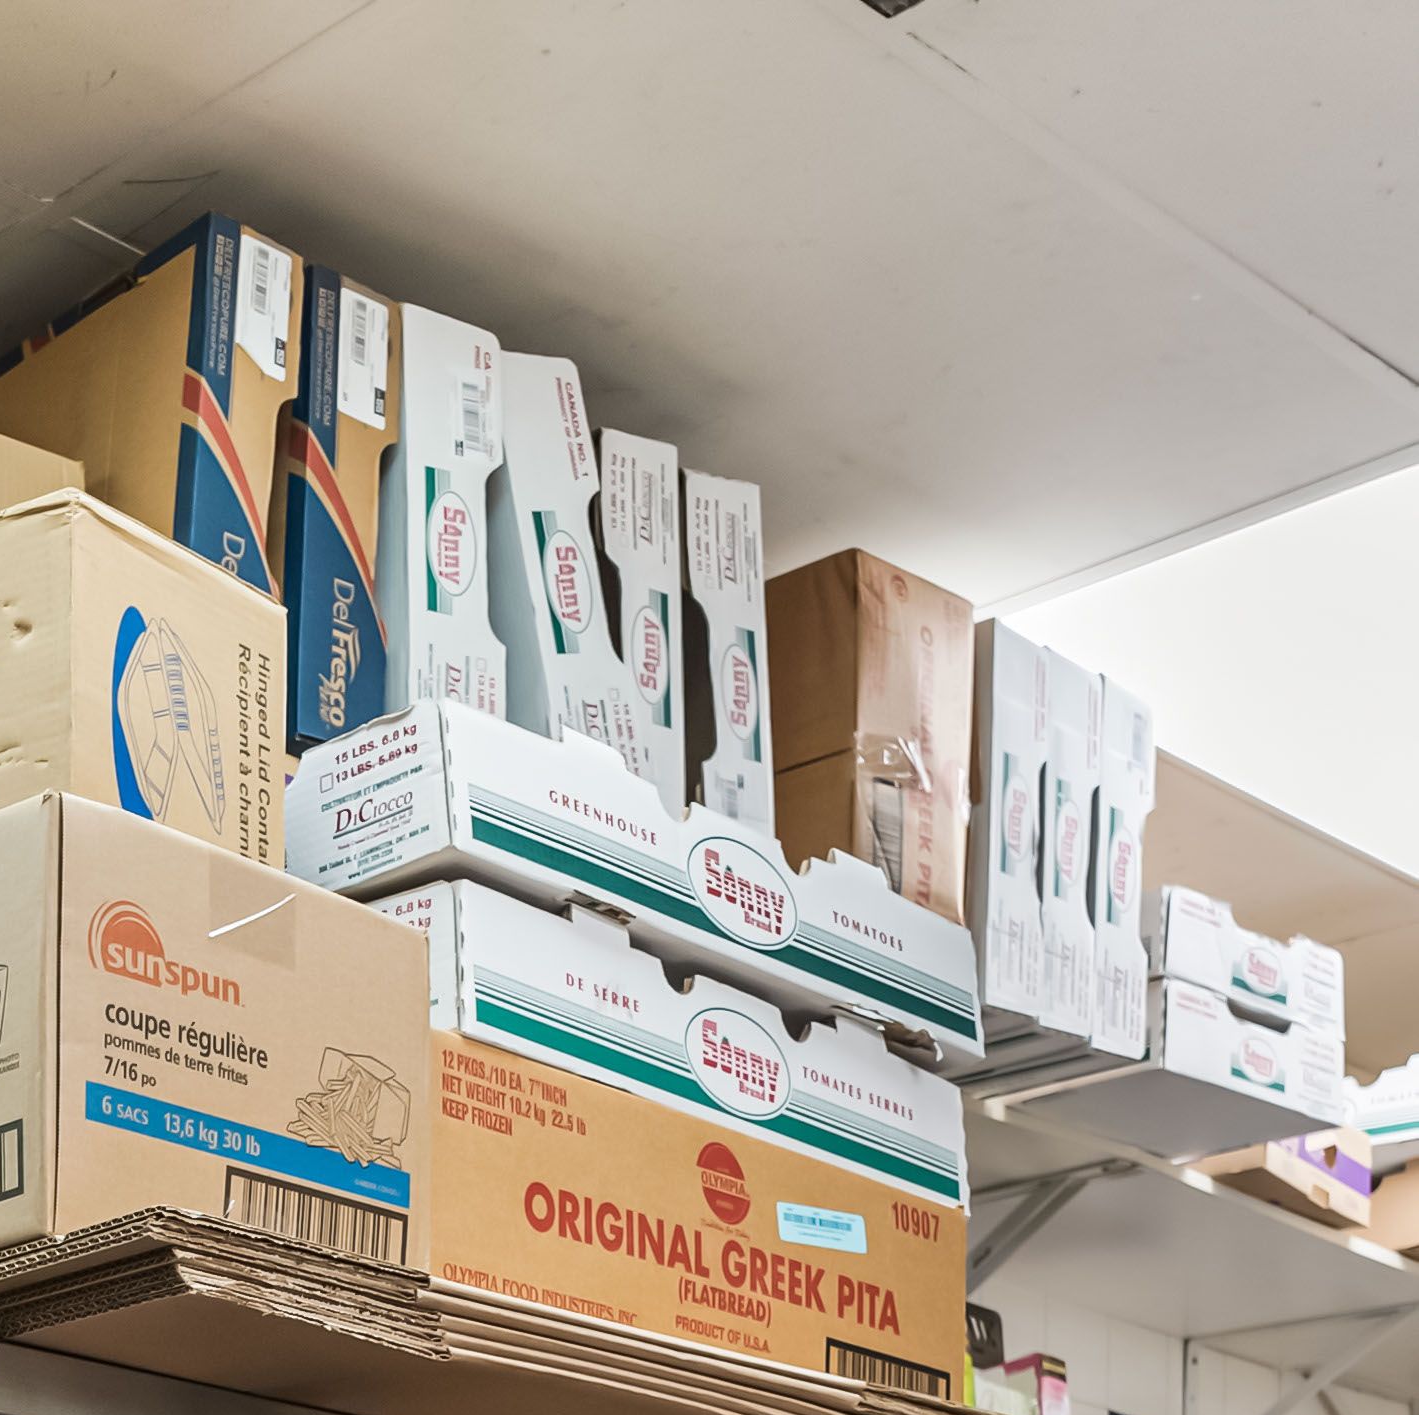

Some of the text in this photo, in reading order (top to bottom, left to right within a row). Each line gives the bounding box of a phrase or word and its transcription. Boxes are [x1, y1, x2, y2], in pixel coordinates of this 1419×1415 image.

[255, 652, 271, 740] Hinged
[258, 743, 271, 783] Lid
[335, 724, 417, 765] 15 LBS. 6.8 kg
[335, 770, 348, 784] 13
[404, 743, 418, 755] kg
[548, 789, 657, 846] GREENHOUSE
[417, 898, 432, 910] kg
[418, 917, 432, 929] kg
[832, 910, 903, 952] TOMATOES
[106, 941, 242, 1007] sunspun
[566, 972, 641, 1013] DE SERRE
[104, 1002, 269, 1069] coupe régulière
[103, 1032, 249, 1086] pommes de terre frites
[103, 1054, 158, 1088] 7/16 po
[441, 1049, 455, 1070] 12
[802, 1065, 862, 1100] TOMATES
[441, 1072, 587, 1137] NET WEIGHT 10.2 kg 22.5 lb
[441, 1096, 514, 1137] KEEP FROZEN
[101, 1095, 261, 1157] 6 SACS 13,6 kg 30 lb
[701, 1169, 747, 1195] OLYMPIA
[891, 1200, 940, 1243] 10907
[524, 1181, 710, 1280] ORIGINAL
[720, 1238, 827, 1313] GREEK
[837, 1273, 901, 1337] PITA
[442, 1262, 499, 1293] OLYMPIA
[501, 1278, 539, 1302] FOOD
[678, 1275, 772, 1329] (FLATBREAD)
[674, 1313, 725, 1341] PRODUCT
[727, 1327, 742, 1345] OF
